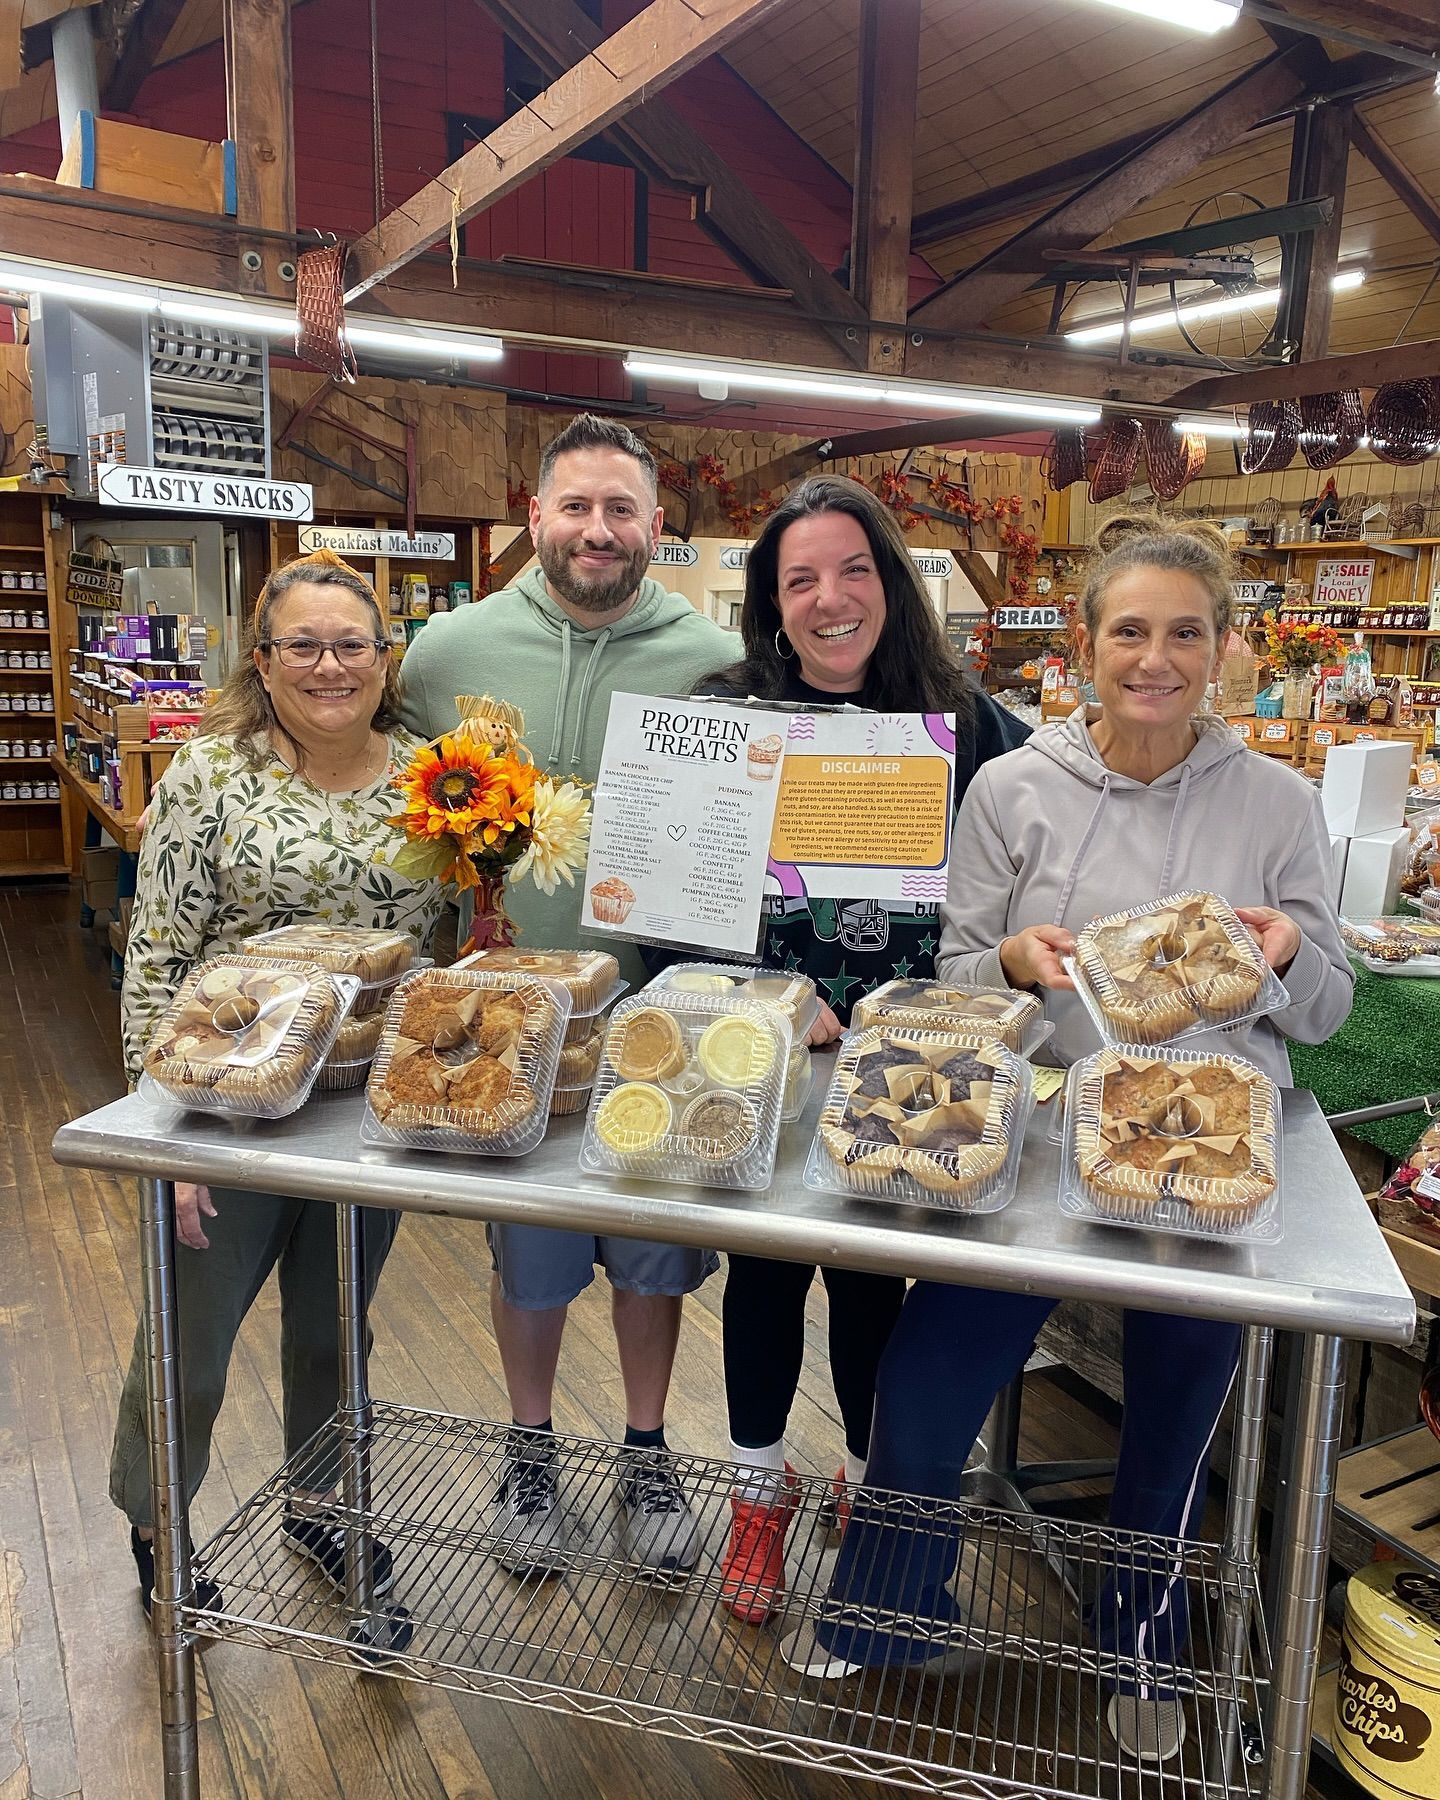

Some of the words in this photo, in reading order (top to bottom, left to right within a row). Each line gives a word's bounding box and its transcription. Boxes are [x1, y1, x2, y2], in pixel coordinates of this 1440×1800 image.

[127, 474, 203, 503] TASTY
[214, 482, 294, 512] SNACKS
[312, 531, 382, 551] Breakfast
[388, 535, 442, 554] Makins'
[663, 547, 689, 562] PIES
[1340, 564, 1370, 577] SALE
[74, 573, 116, 589] CIDER
[1331, 578, 1355, 586] Local
[73, 590, 114, 606] DONUTS
[1232, 584, 1260, 598] NEY
[1316, 584, 1368, 602] HONEY
[996, 610, 1066, 625] BREADS
[640, 710, 750, 742] PROTEIN
[644, 732, 738, 763] TREATS
[621, 762, 649, 770] MUFFINS
[821, 761, 901, 774] DISCLAIMER
[627, 773, 659, 782] CHOCOLATE
[718, 786, 753, 796] PUDDINGS
[714, 800, 741, 808] BANANA
[619, 809, 645, 818] CONFETTI
[710, 815, 739, 823] CANNOLI
[625, 823, 657, 832] CHOCOLATE
[624, 834, 653, 843] BLUEBERRY
[722, 831, 748, 840] CRUMBS
[689, 842, 721, 851] COCONUT
[722, 847, 752, 856] CARAMEL
[702, 860, 734, 869] CONFETTI
[688, 873, 712, 881] COOKIE
[714, 877, 743, 887] CRUMBLE
[682, 888, 710, 896] PUMPKIN
[711, 892, 746, 903] (SEASONAL)
[1338, 1659, 1397, 1713] harles
[1342, 1697, 1404, 1745] Chips
